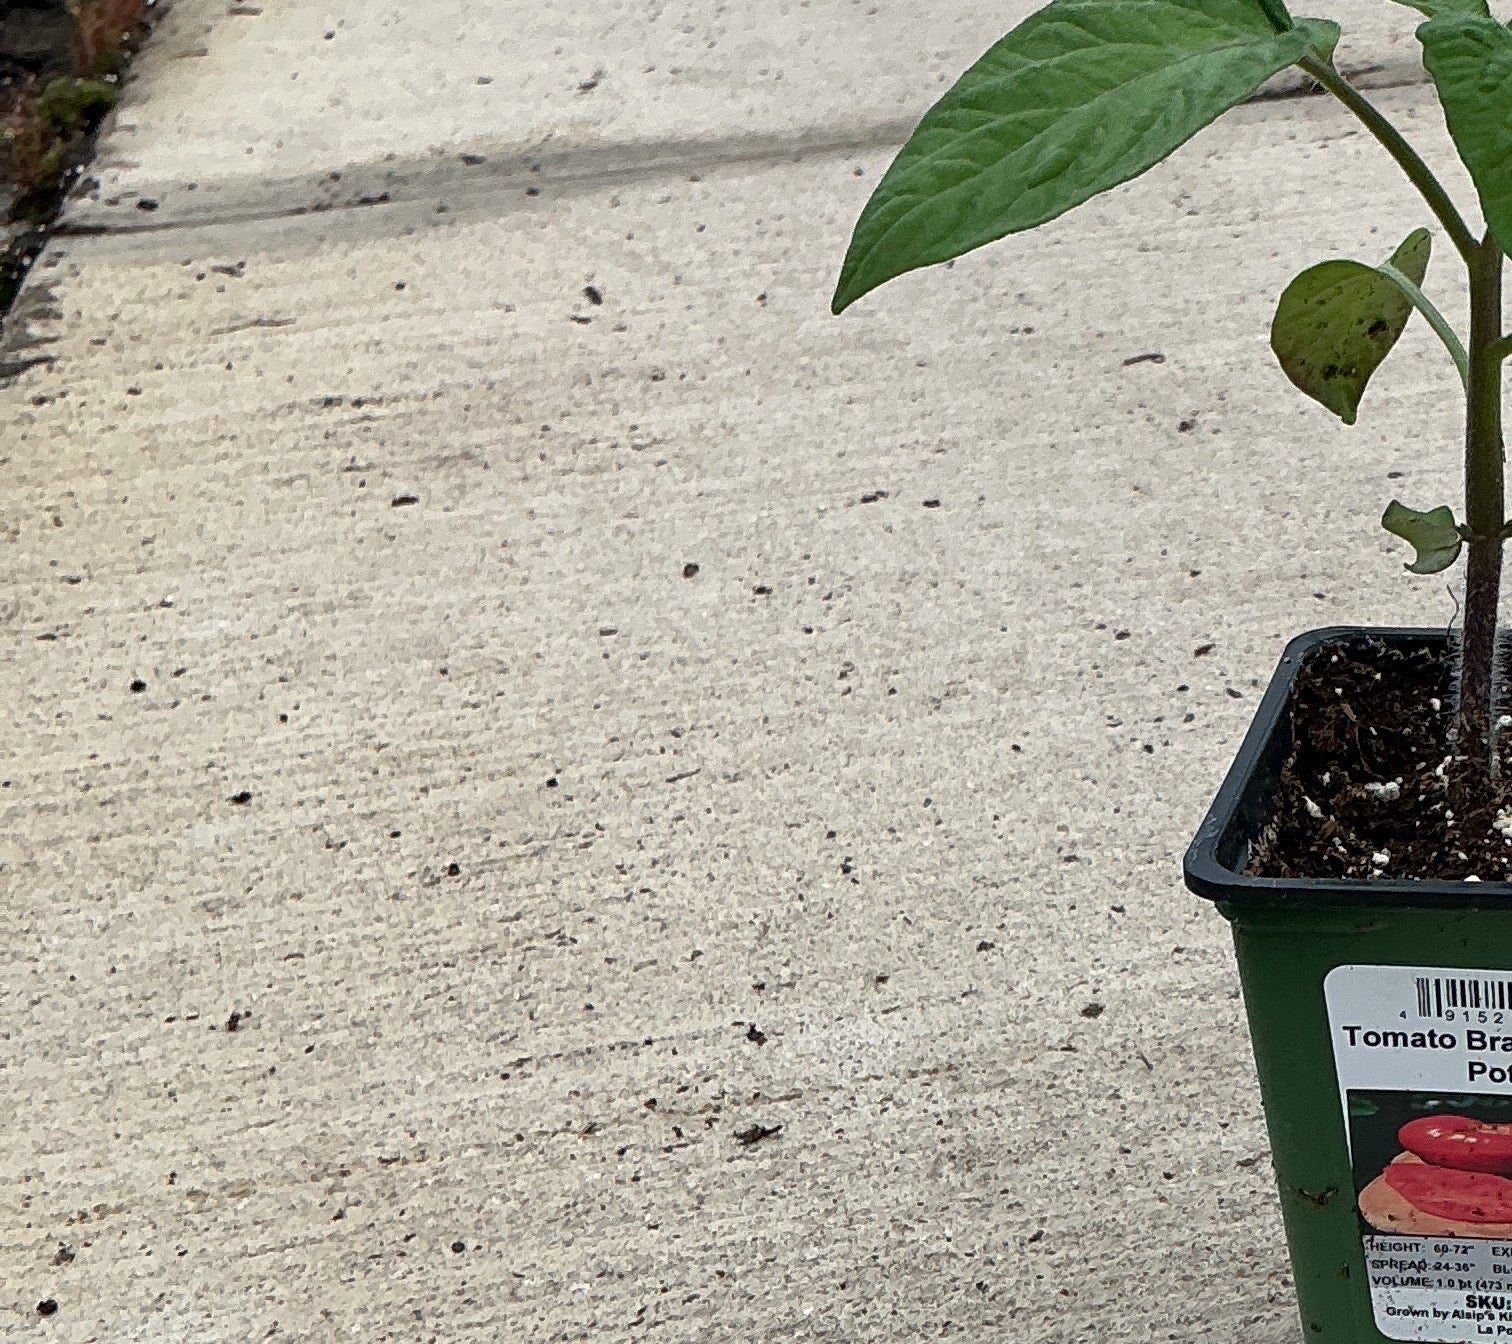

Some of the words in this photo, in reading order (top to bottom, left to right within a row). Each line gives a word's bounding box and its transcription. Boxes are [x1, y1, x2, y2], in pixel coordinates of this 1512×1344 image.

[1342, 1025, 1457, 1049] Tomato
[1370, 1242, 1425, 1253] HEIGHT:
[1371, 1259, 1431, 1271] SPREAD:
[1372, 1276, 1433, 1287] VOLUME:
[1437, 1278, 1455, 1288] 1.0
[1458, 1279, 1472, 1290] pt
[1476, 1279, 1502, 1290] (473
[1466, 1295, 1511, 1310] SKU:
[1386, 1307, 1429, 1318] Grown
[1433, 1308, 1450, 1319] by
[1452, 1309, 1495, 1322] Alsip's
[1478, 1325, 1493, 1335] La
